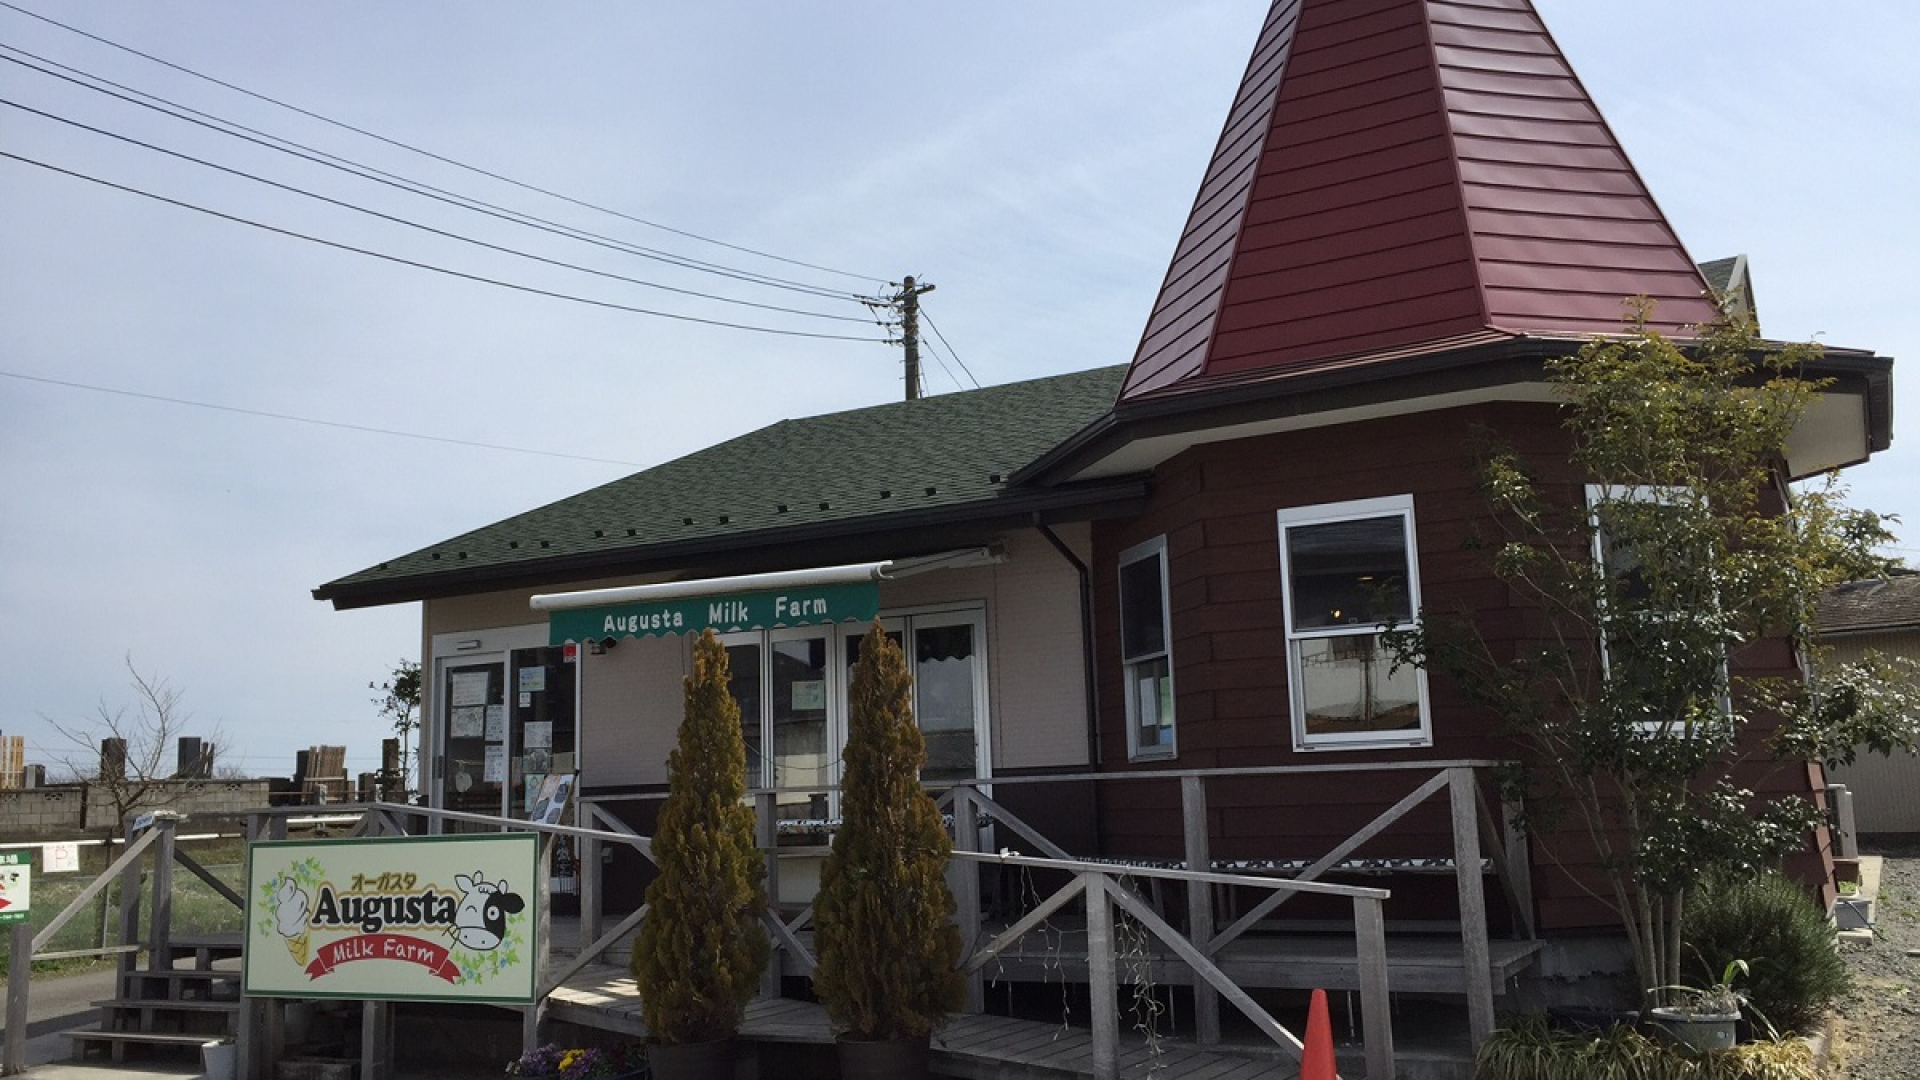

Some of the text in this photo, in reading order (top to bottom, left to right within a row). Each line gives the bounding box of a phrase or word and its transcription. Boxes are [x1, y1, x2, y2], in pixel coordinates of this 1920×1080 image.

[603, 596, 827, 632] Augusta Milk Farm
[351, 872, 417, 891] オーガスタ
[311, 887, 456, 933] Augusta
[332, 938, 435, 964] Milk Farm
